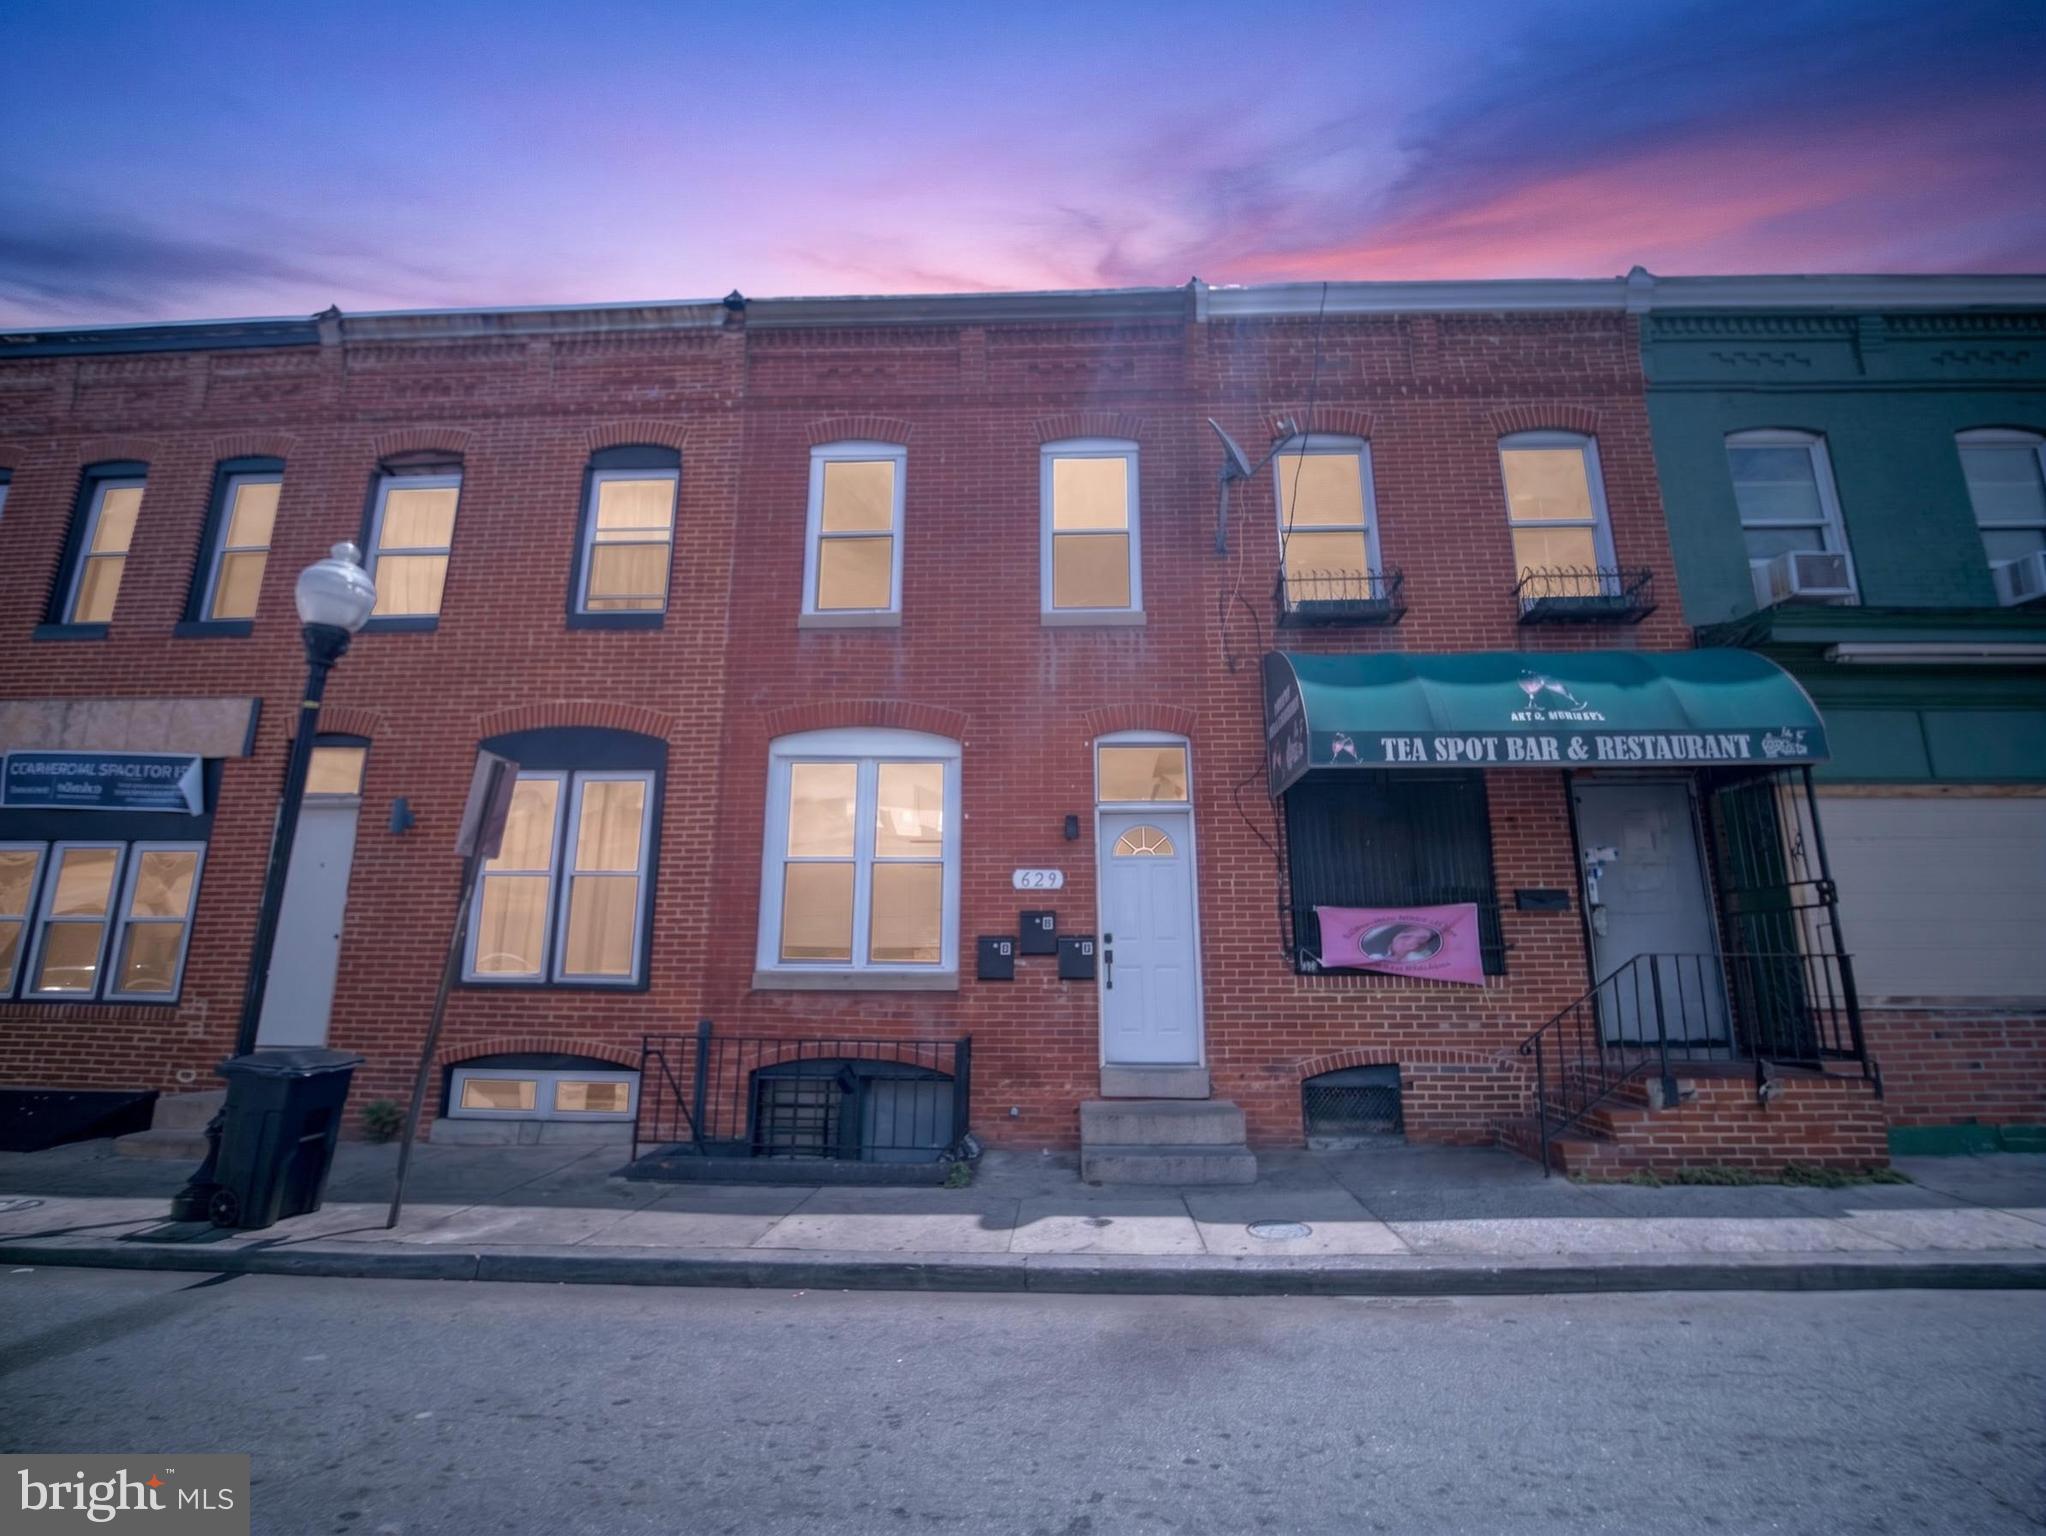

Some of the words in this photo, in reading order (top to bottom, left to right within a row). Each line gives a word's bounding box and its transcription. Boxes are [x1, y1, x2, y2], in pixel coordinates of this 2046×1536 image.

[1381, 737, 1427, 762] TEA
[1434, 736, 1498, 761] SPOT
[1505, 736, 1561, 761] BAR
[1568, 736, 1588, 760] &
[1595, 734, 1751, 760] RESTAURANT
[1021, 872, 1057, 887] 629
